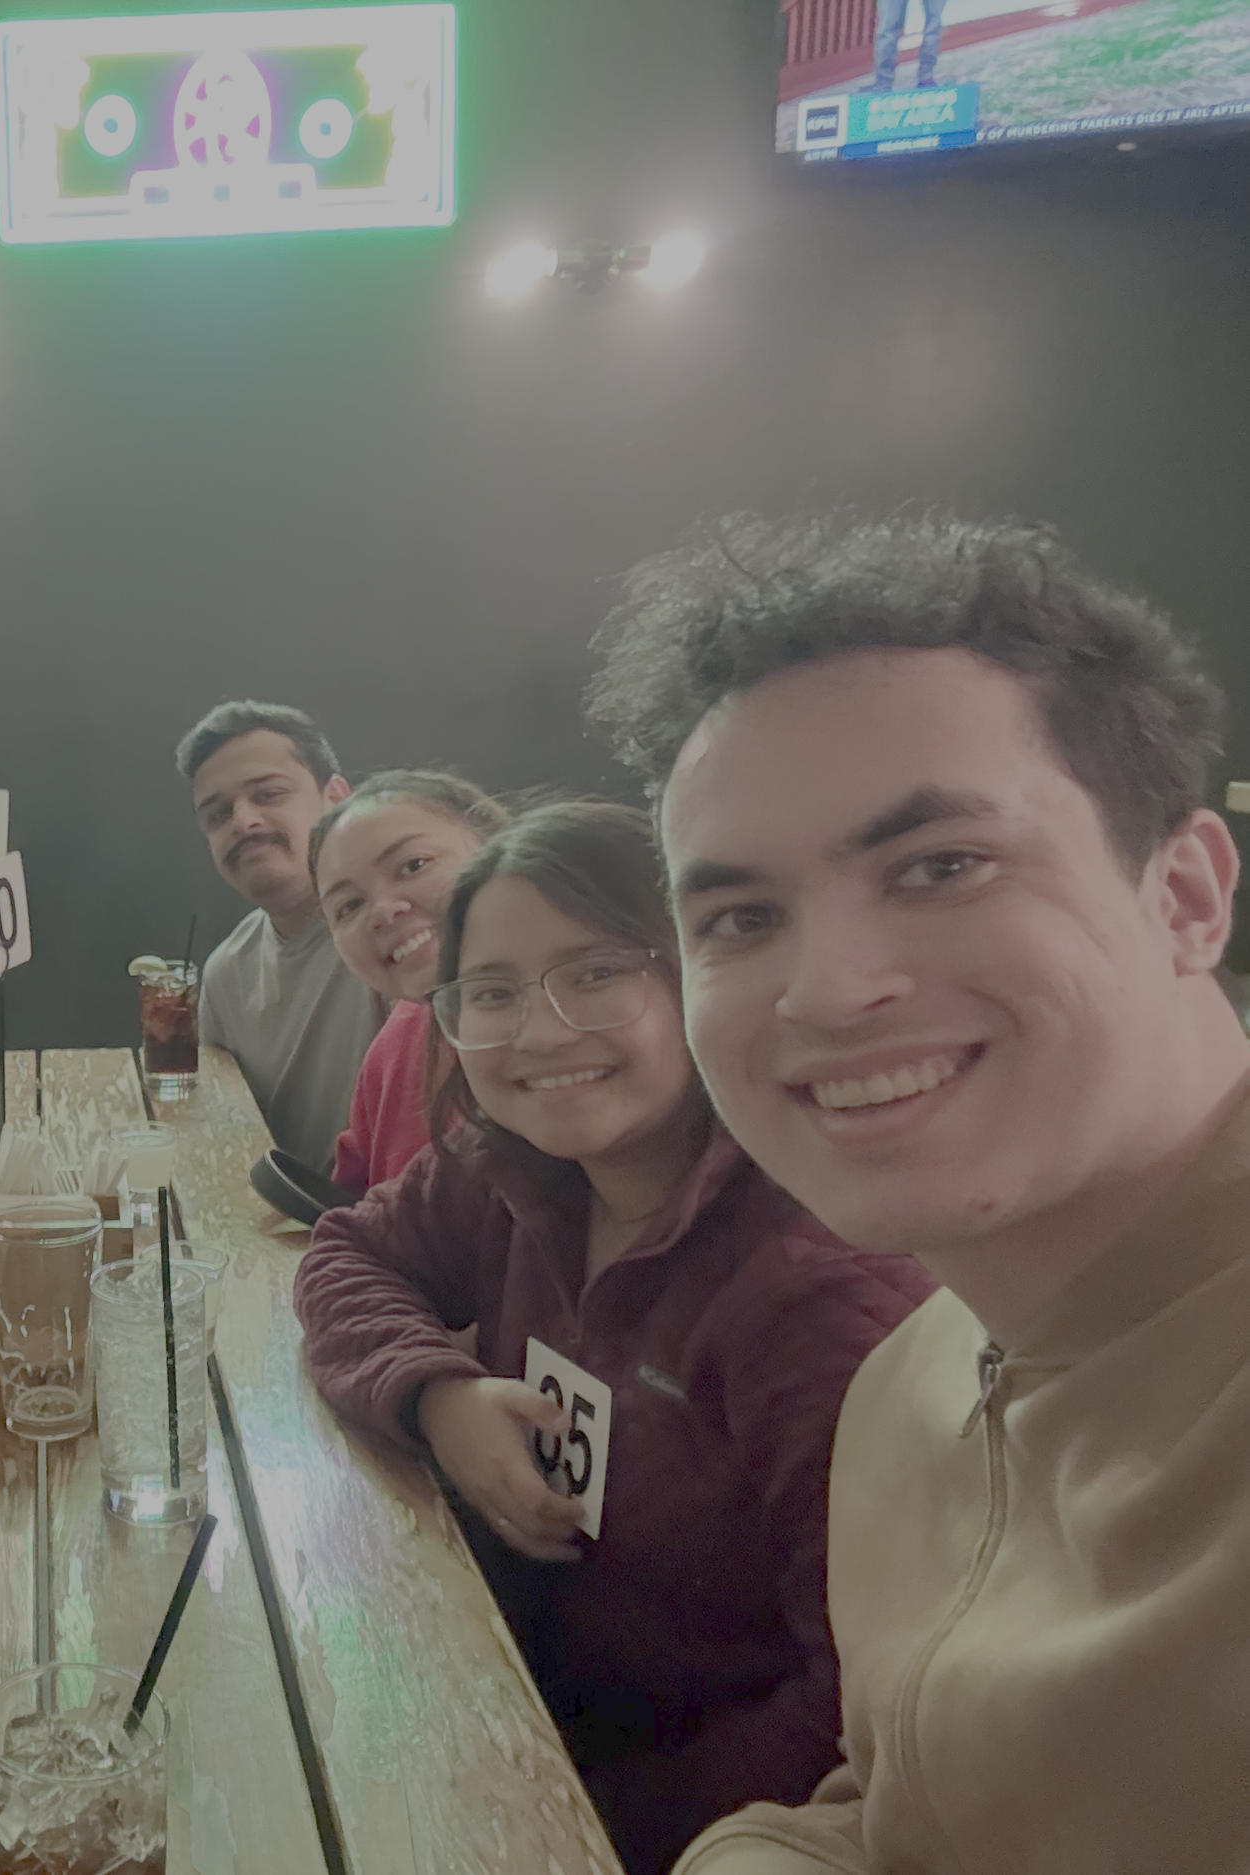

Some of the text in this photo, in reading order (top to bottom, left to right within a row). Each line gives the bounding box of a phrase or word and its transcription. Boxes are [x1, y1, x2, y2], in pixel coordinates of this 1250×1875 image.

[987, 127, 1004, 140] OF
[1006, 121, 1079, 139] MURDERING
[1080, 114, 1134, 131] PARENTS
[1135, 110, 1164, 125] DIES
[1166, 109, 1181, 121] IN
[1182, 106, 1209, 119] JAIL
